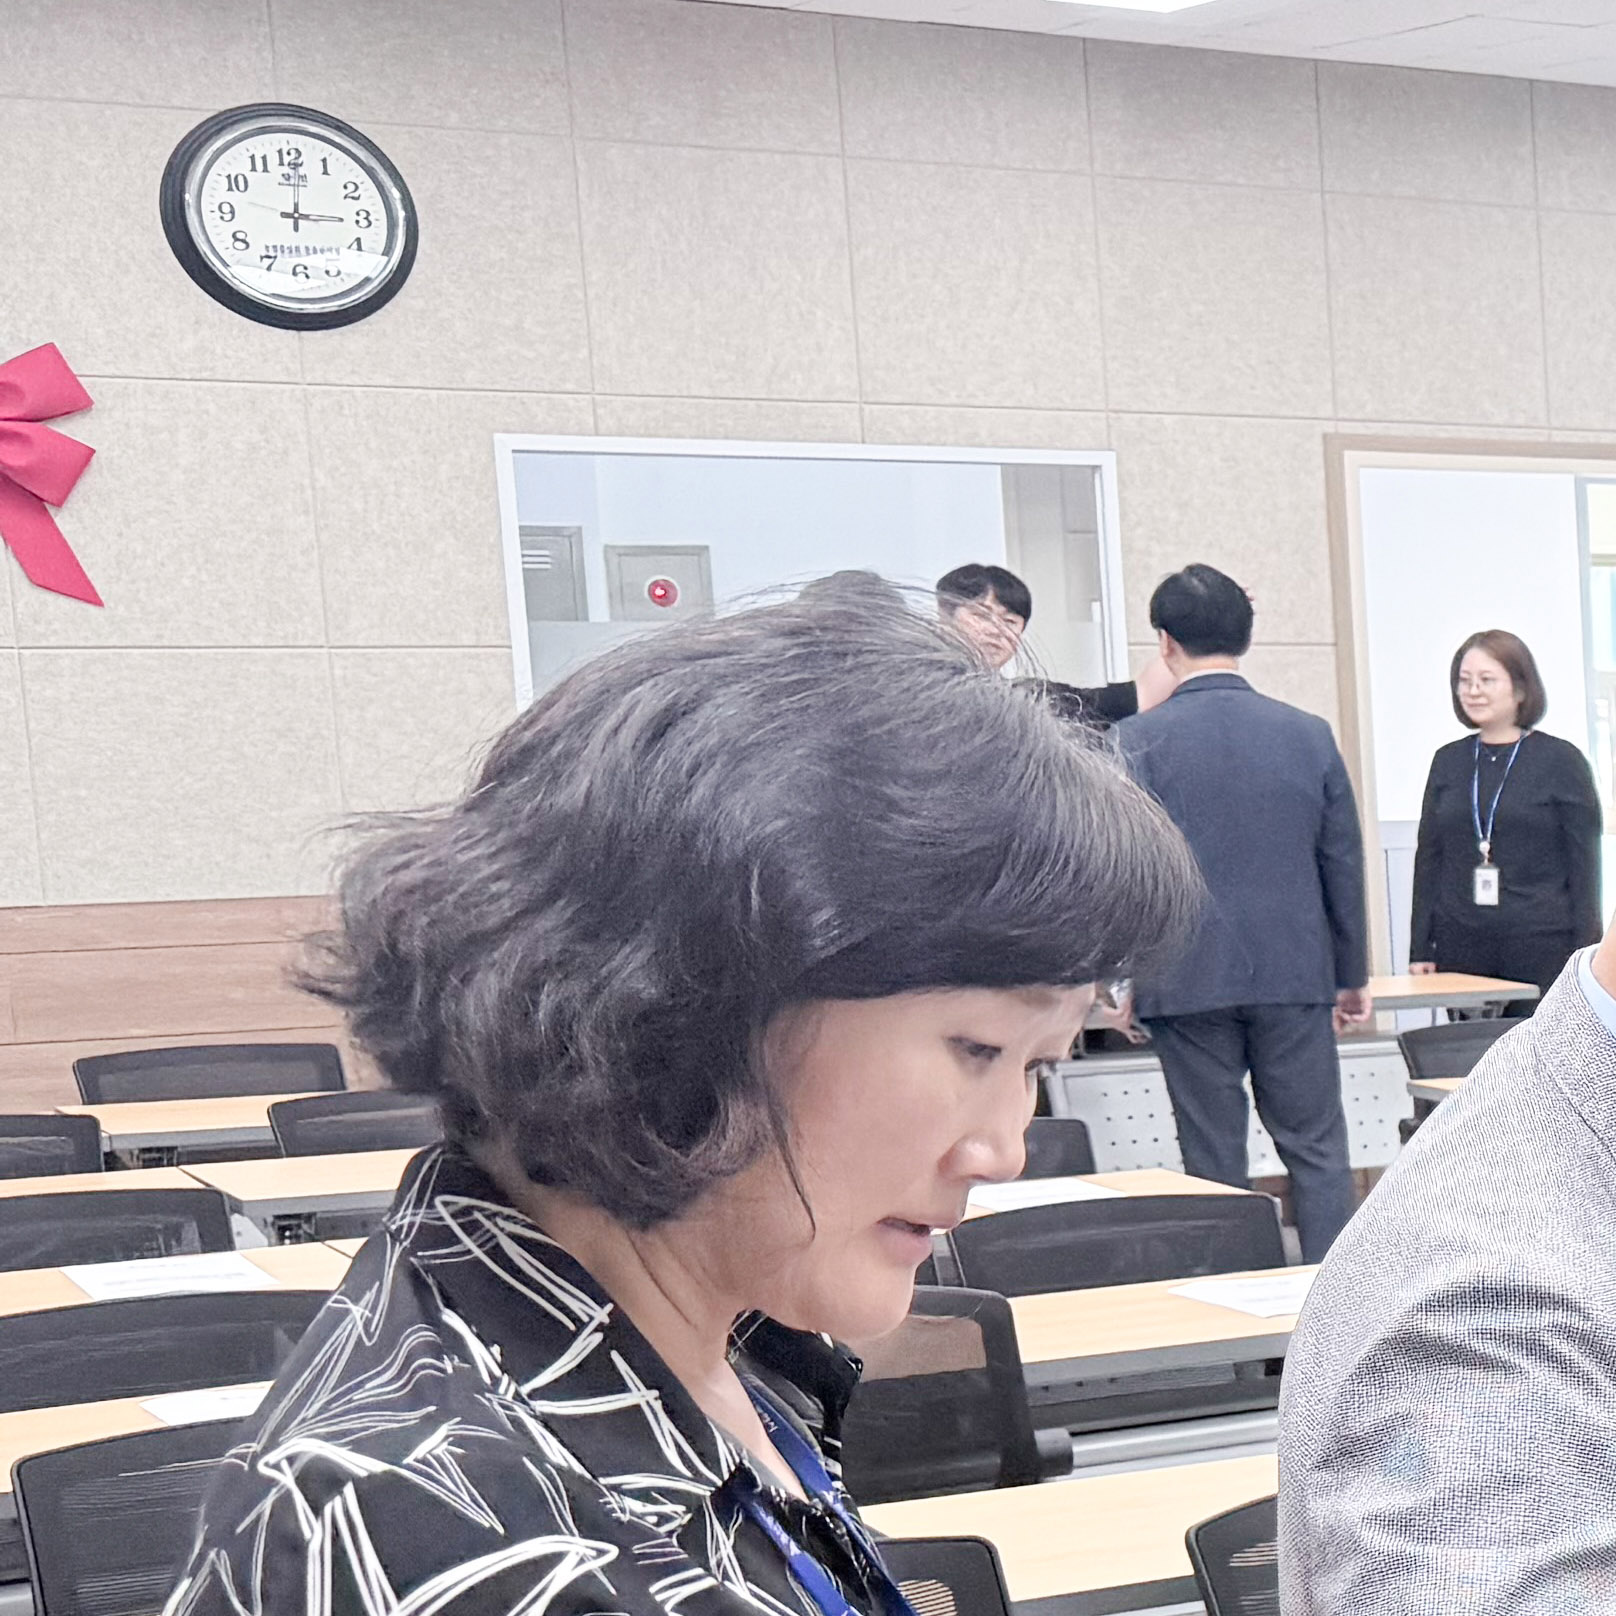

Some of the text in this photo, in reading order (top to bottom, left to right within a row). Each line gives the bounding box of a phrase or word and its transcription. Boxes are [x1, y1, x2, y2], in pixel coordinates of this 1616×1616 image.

[249, 154, 270, 173] 11
[277, 148, 303, 169] 12
[320, 157, 331, 176] 1
[226, 173, 248, 192] 10
[343, 181, 361, 201] 2
[218, 201, 236, 222] 9
[355, 209, 372, 229] 3
[231, 231, 250, 251] 8
[347, 237, 363, 252] 4
[260, 255, 277, 272] 7
[292, 264, 310, 283] 6
